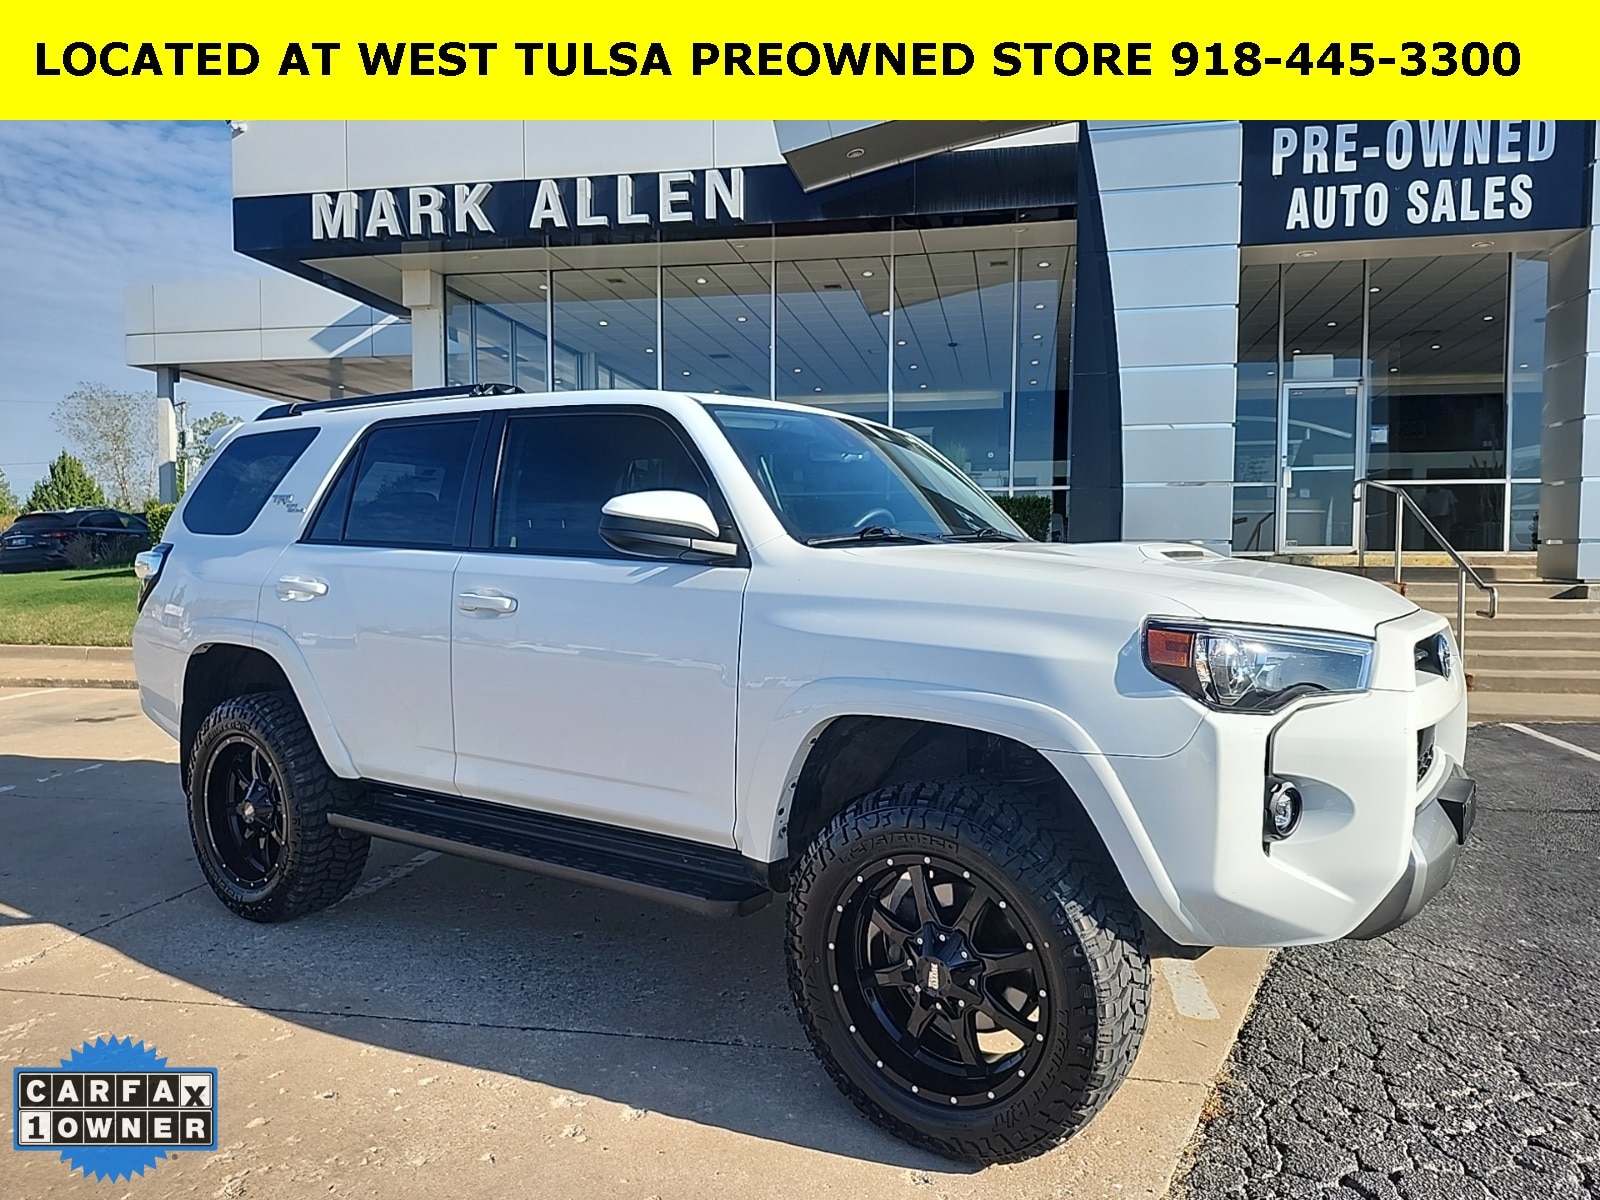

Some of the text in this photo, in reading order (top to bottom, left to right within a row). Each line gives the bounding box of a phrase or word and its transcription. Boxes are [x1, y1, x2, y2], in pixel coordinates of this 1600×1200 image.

[1271, 120, 1556, 176] PRE-OWNED
[311, 167, 746, 241] MARK ALLEN
[1285, 173, 1534, 231] AUTO SALES
